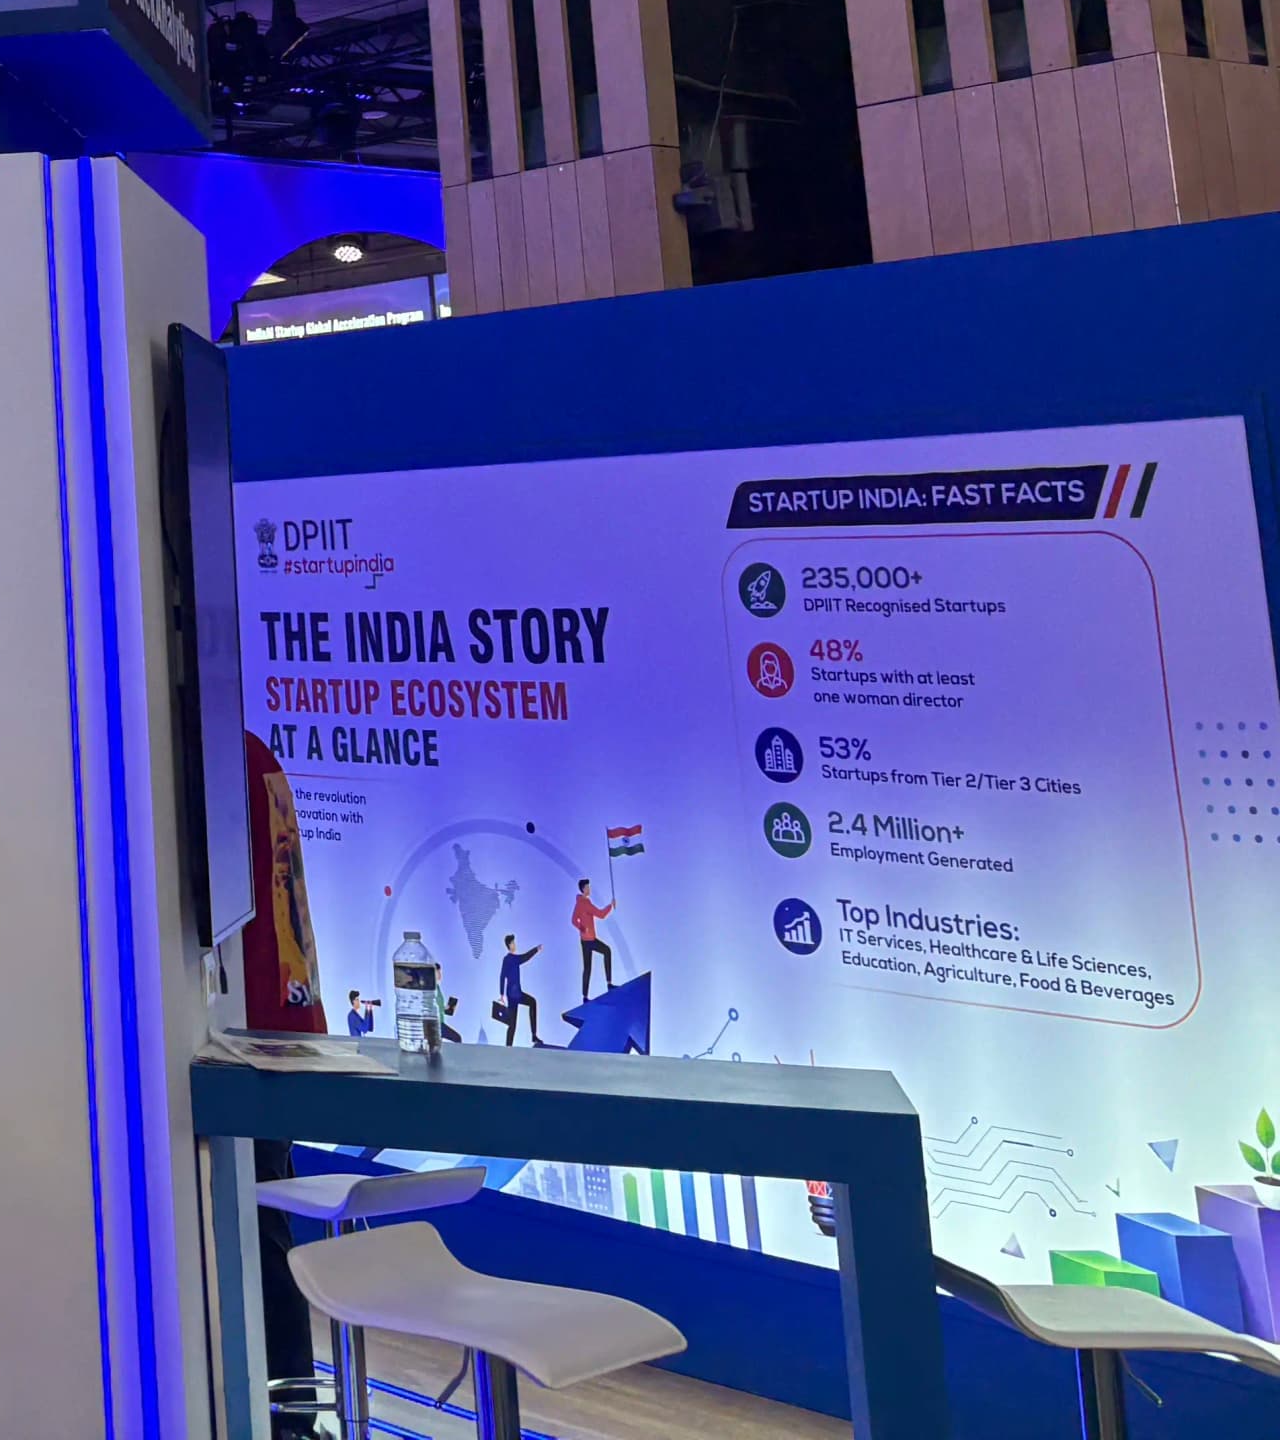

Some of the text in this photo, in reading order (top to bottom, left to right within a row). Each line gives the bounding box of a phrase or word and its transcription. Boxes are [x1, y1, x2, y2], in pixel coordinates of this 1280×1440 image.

[748, 479, 1086, 513] STARTUP INDIA: FAST FACTS
[284, 518, 353, 551] DPIIT
[284, 553, 394, 578] #startupindia
[801, 566, 923, 591] 235,000+
[804, 597, 1006, 618] DPIIT Recognised Startups
[260, 607, 609, 664] THE INDIA STORY
[809, 639, 863, 662] 48%
[811, 666, 975, 687] Startups with at least
[266, 676, 569, 720] STARTUP ECOSYSTEM
[813, 691, 964, 709] one woman director
[269, 724, 439, 766] AT A GLANCE
[818, 736, 872, 762] 53%
[822, 764, 1082, 795] Startups from Tier 2/Tier 3 Cities
[295, 788, 367, 805] the revolution
[340, 810, 364, 824] with
[828, 811, 965, 845] 2.4 Million+
[316, 827, 341, 841] India
[830, 842, 1014, 873] Employment Generated
[836, 898, 1021, 941] Top Industries:
[839, 928, 1152, 981] IT Services, Healthcare & Life Sciences,
[841, 950, 1175, 1010] Education, Agriculture, Food & Beverages
